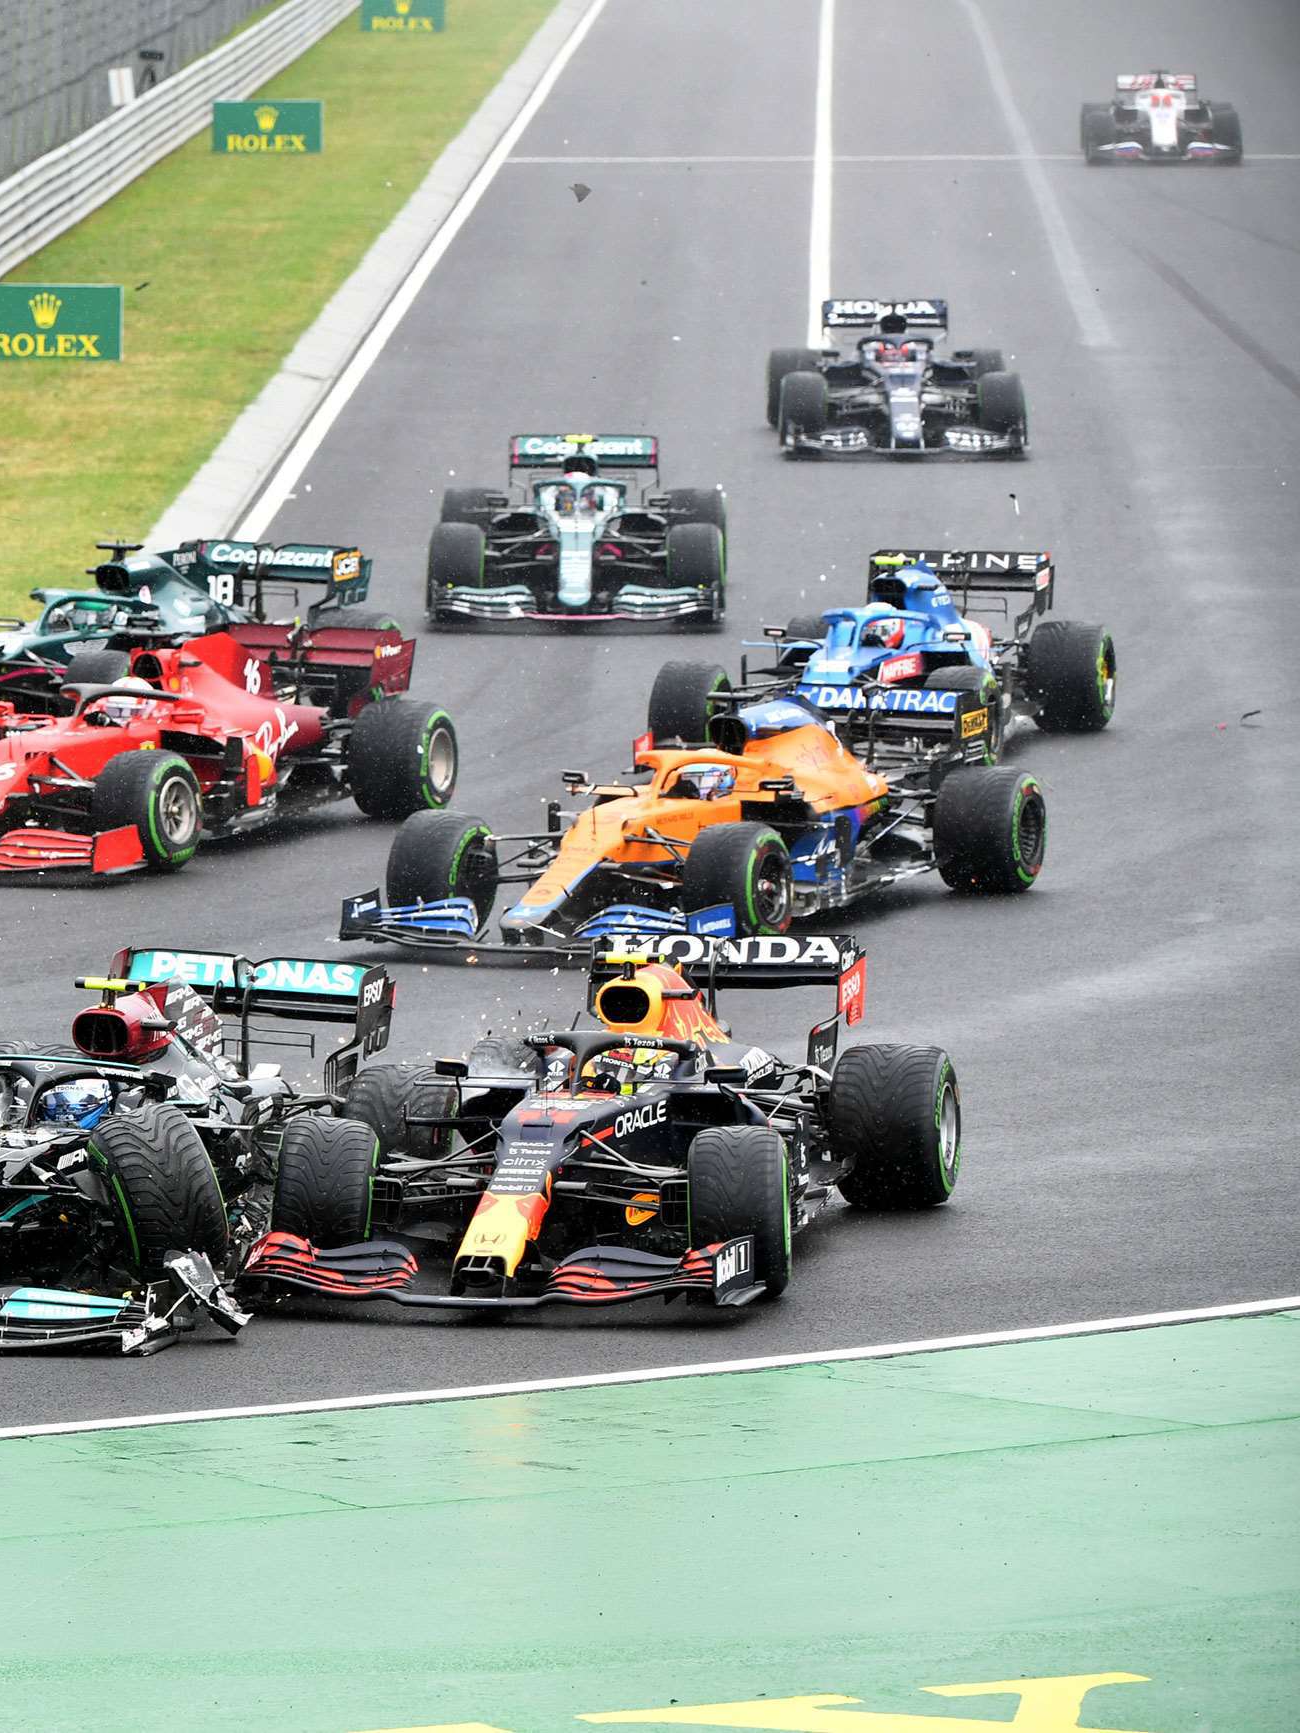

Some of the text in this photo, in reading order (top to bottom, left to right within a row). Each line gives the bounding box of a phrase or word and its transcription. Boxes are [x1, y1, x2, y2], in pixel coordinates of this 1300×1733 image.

[226, 134, 305, 152] ROLEX
[210, 544, 334, 570] Cognizant
[336, 555, 361, 576] JCB
[899, 553, 1037, 569] LPINE
[207, 574, 235, 607] 18
[243, 658, 262, 696] 16
[610, 935, 840, 965] HONDA
[632, 1037, 657, 1047] Tezos
[602, 1056, 635, 1070] HONDA
[615, 1100, 667, 1138] ORACLE
[502, 1157, 548, 1167] citrix
